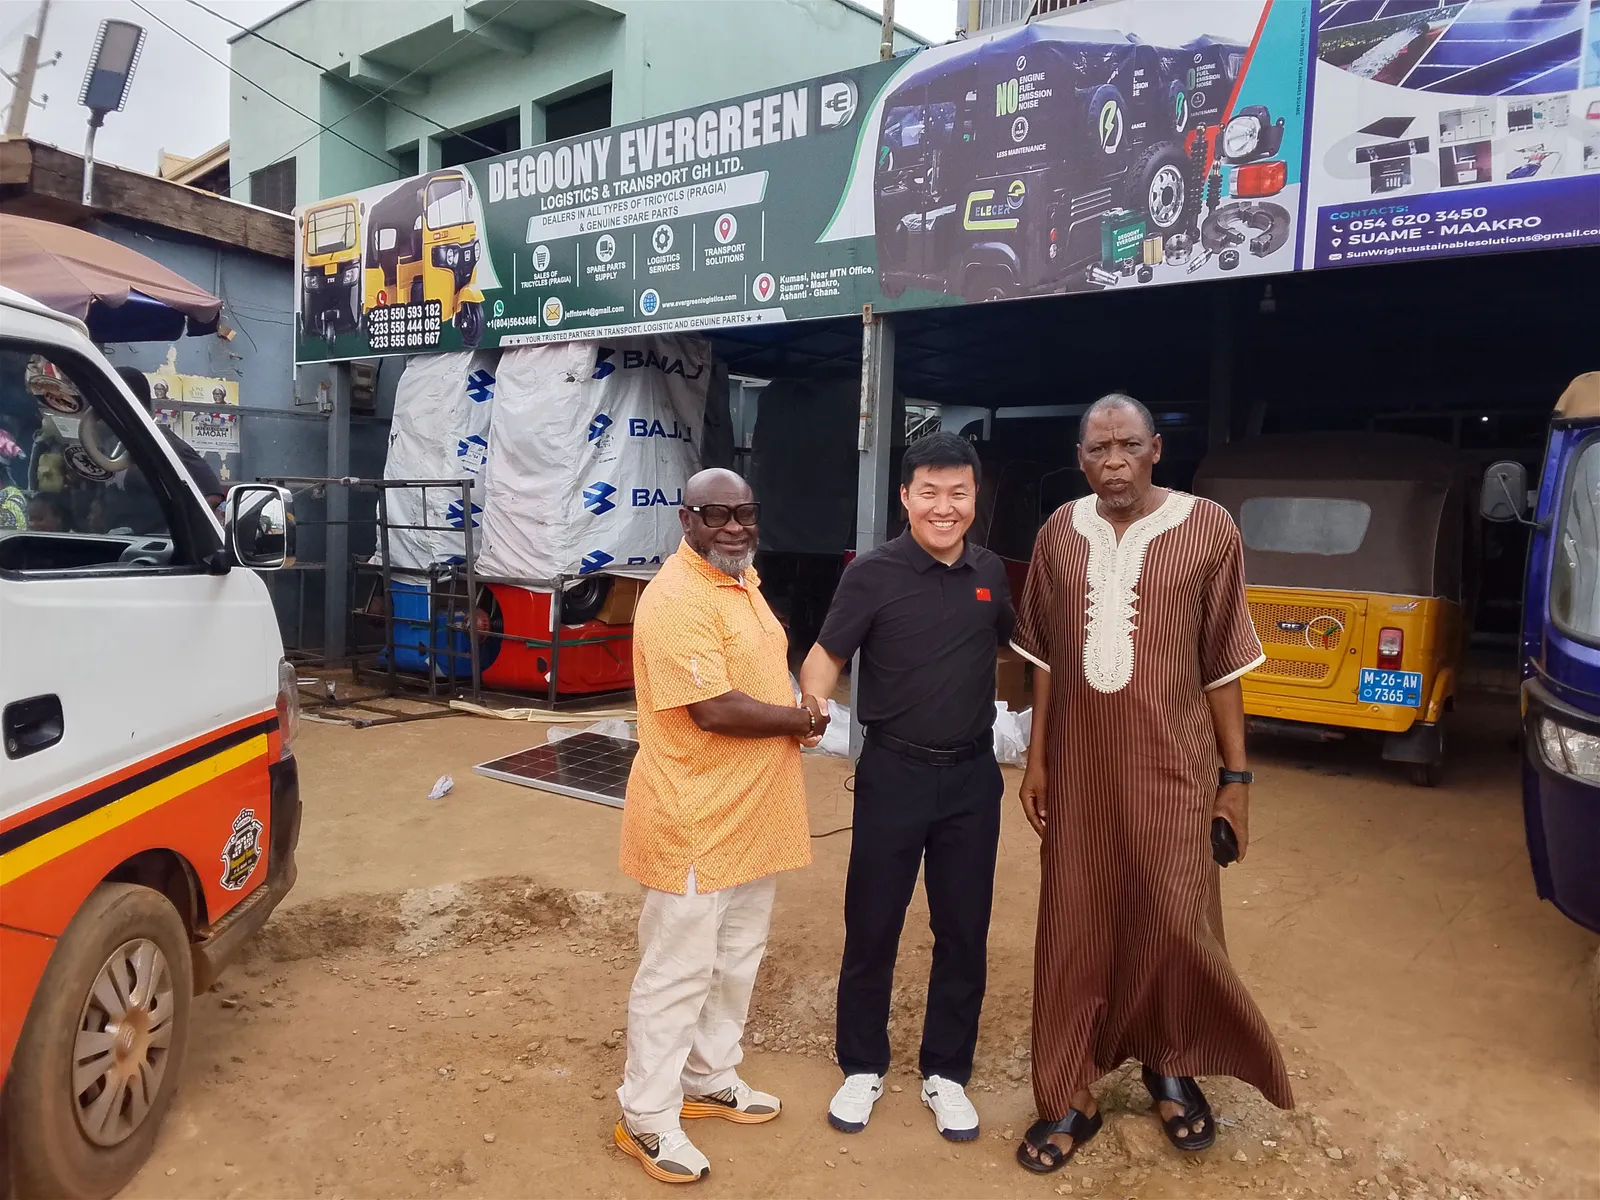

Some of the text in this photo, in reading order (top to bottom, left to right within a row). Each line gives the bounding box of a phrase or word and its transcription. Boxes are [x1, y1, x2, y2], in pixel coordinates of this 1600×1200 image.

[1019, 72, 1045, 84] ENGINE
[1018, 89, 1052, 102] EMISSION
[1019, 83, 1035, 93] FUEL
[996, 78, 1018, 117] NO
[1018, 99, 1039, 110] NOISE
[489, 87, 808, 203] DEGOONY EVERGREEN
[996, 143, 1046, 158] LESS MAINTENANCE
[541, 157, 744, 211] LOGISTICS & TRANSPORT GH LTD.
[542, 181, 727, 226] DEALERS IN ALL TYPES OF TRICYCLS (PRAGIA)
[579, 206, 678, 232] & GENUINE SPARE PARTS
[1330, 205, 1409, 220] CONTACTS:
[1349, 207, 1488, 231] 054 620 3450
[1348, 228, 1422, 245] SUAME
[1440, 216, 1542, 235] MAAKRO
[704, 243, 746, 256] TRANSPORT
[1346, 229, 1600, 258] SunWrightsustainablesolutions@gmail.co
[647, 253, 680, 265] LOGISTICS
[705, 253, 744, 266] SOLUTIONS
[586, 262, 626, 274] SPARE PARTS
[649, 262, 680, 274] SERVICES
[780, 266, 874, 284] Kumasi, Near MTN Office,
[521, 276, 571, 288] TRICYCLES (PRAGIA)
[534, 272, 550, 280] SALES
[595, 272, 617, 281] SUPPLY
[780, 283, 804, 292] Suame
[811, 279, 840, 289] Maakro,
[662, 293, 737, 308] www.evergreenlogistics.com
[780, 290, 807, 301] Ashanti
[814, 287, 840, 297] Ghana.
[369, 303, 440, 321] +233 550 593 182
[369, 318, 440, 335] +233 558 444 062
[542, 331, 567, 341] TRUSTED
[569, 329, 595, 339] PARTNER
[605, 325, 642, 335] TRANSPORT,
[643, 322, 673, 332] LOGISTIC
[675, 320, 689, 329] AND
[691, 317, 720, 327] GENUINE
[722, 314, 745, 323] PARTS
[369, 332, 440, 348] +233 555 606 667
[629, 418, 692, 442] BAJJ
[632, 488, 684, 506] BAJ
[1375, 688, 1404, 702] 7365
